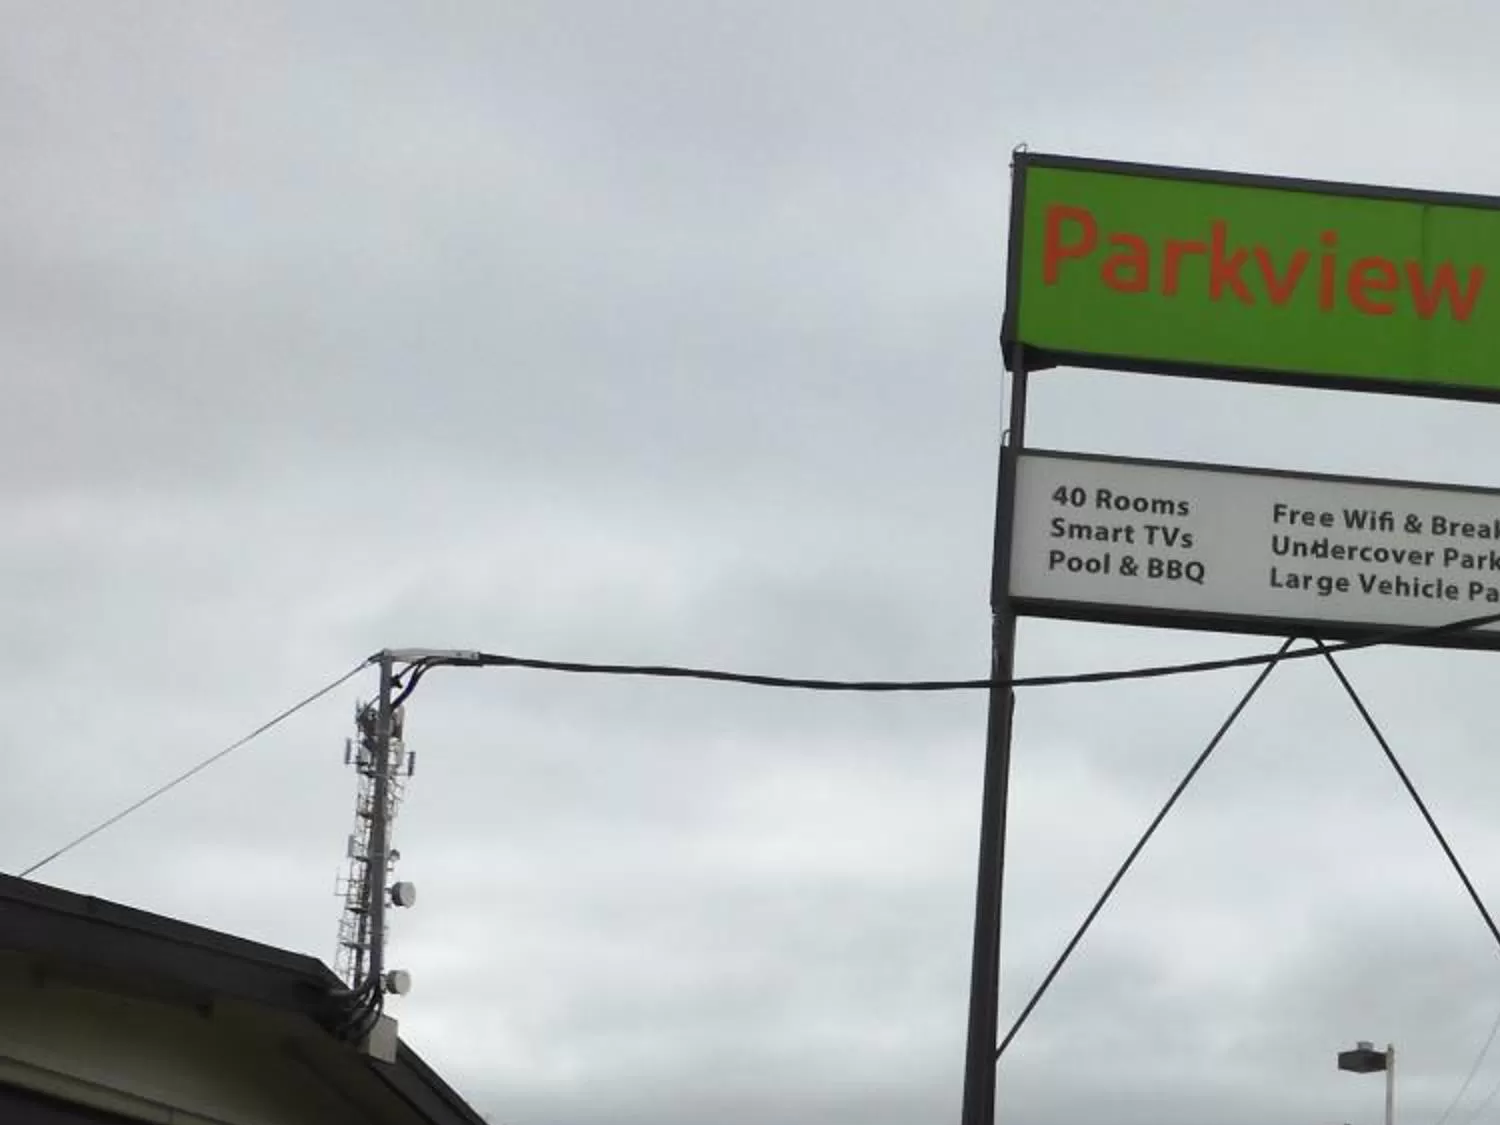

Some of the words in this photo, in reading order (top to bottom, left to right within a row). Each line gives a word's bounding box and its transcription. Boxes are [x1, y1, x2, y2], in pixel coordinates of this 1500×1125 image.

[1042, 203, 1487, 324] Parkview
[1051, 485, 1087, 508] 40
[1096, 488, 1190, 517] Rooms
[1050, 516, 1135, 545] Smart
[1143, 524, 1194, 549] TVs
[1273, 503, 1335, 528] Free
[1343, 508, 1395, 533] Wifi
[1403, 513, 1423, 534] &
[1271, 534, 1435, 567] Undercover
[1048, 549, 1111, 575] Pool
[1118, 555, 1139, 577] &
[1147, 556, 1206, 586] BBQ
[1269, 566, 1350, 597] Large
[1358, 573, 1460, 600] Vehicle
